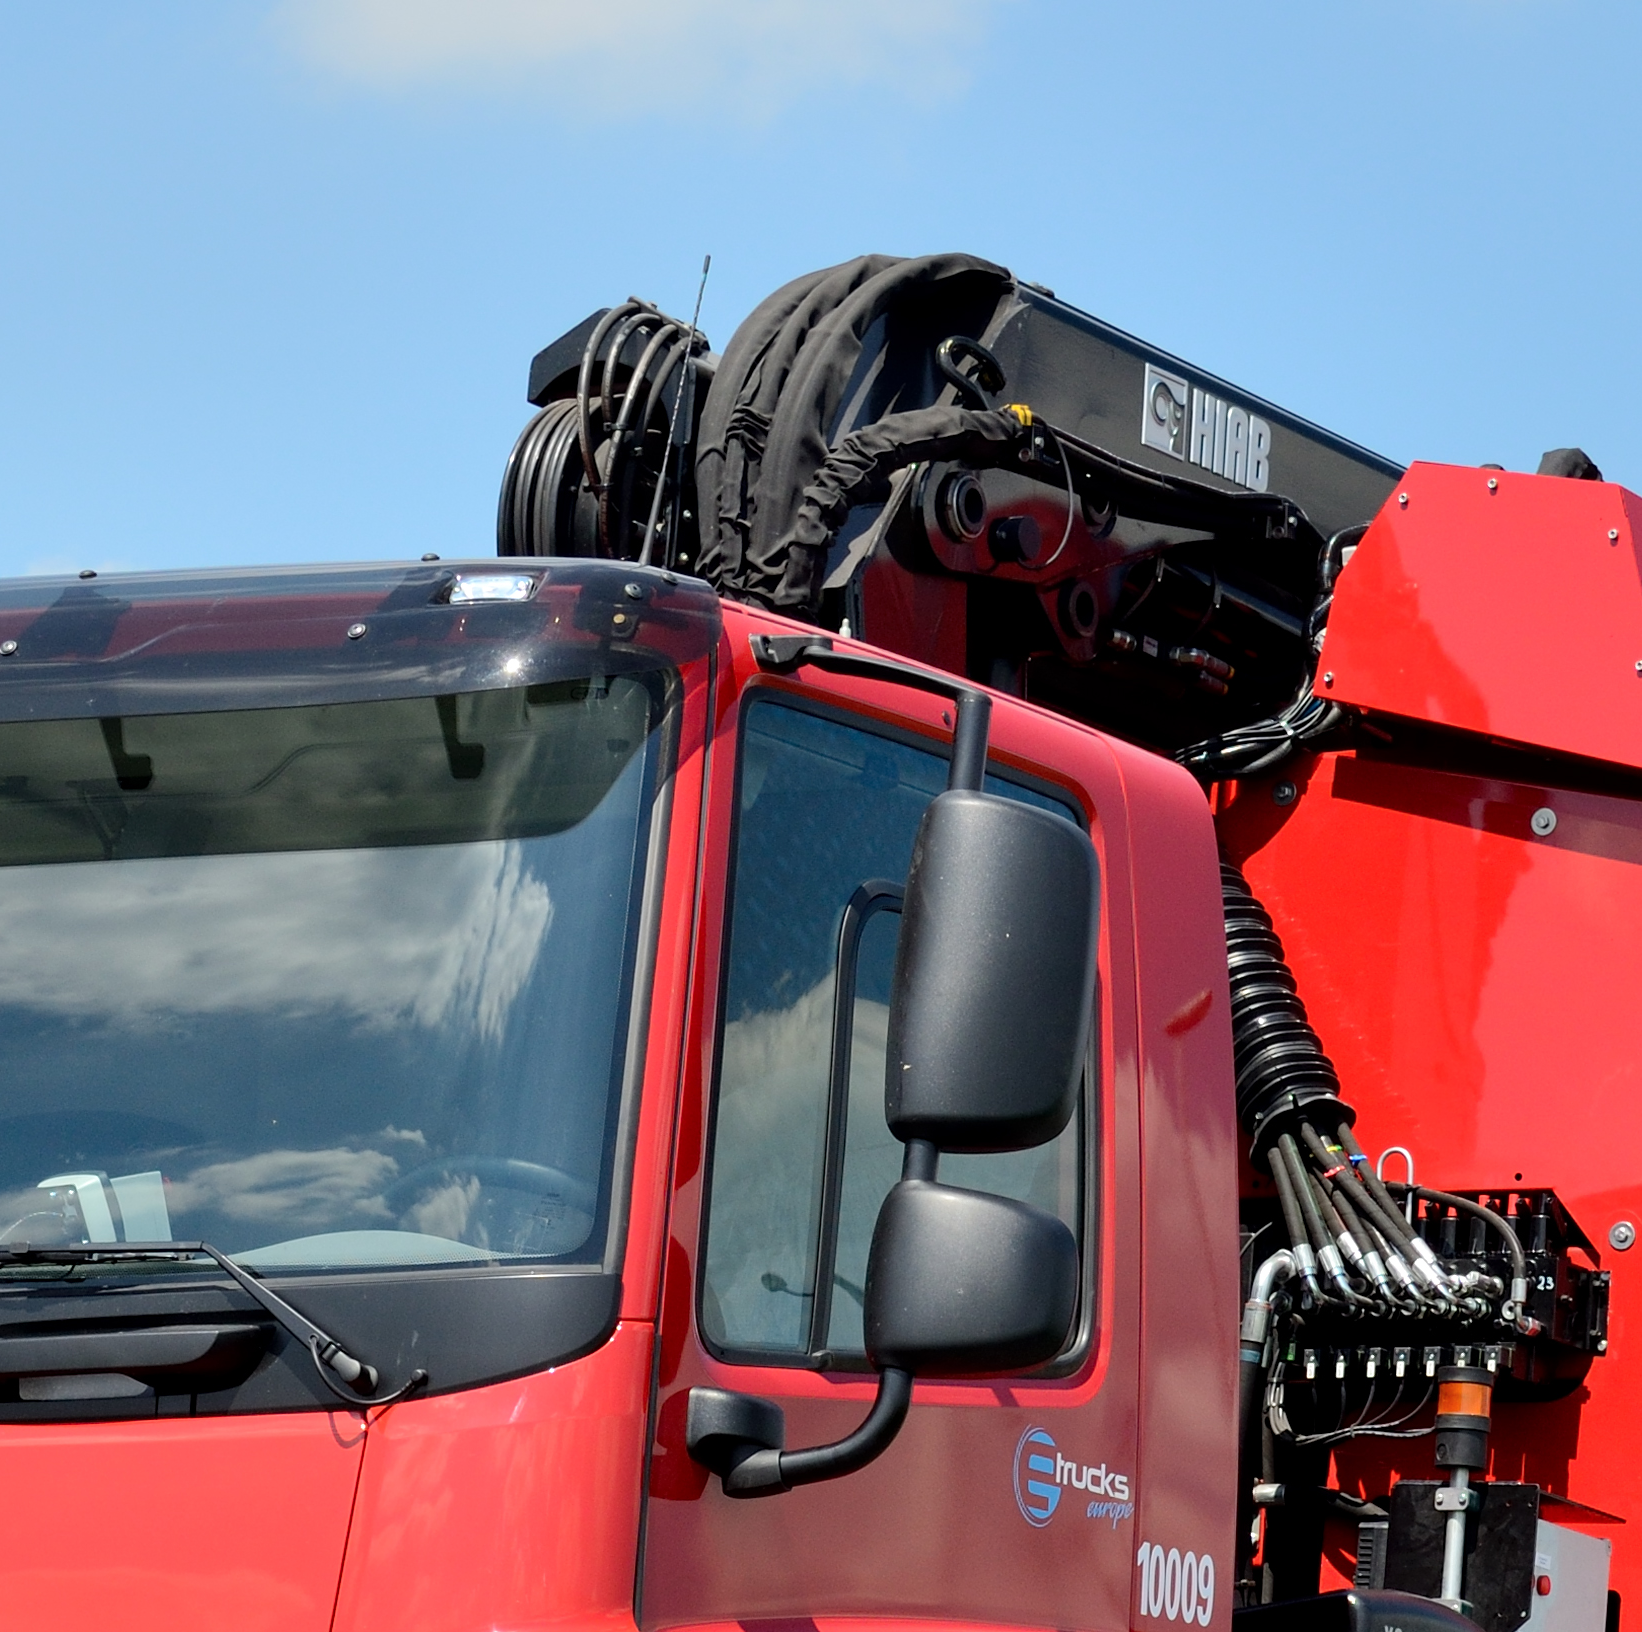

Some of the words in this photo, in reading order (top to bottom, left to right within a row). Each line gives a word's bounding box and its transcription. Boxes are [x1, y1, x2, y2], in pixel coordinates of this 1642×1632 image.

[1189, 388, 1271, 493] HIAB
[1087, 1501, 1134, 1530] europe
[1137, 1541, 1215, 1627] 10009
